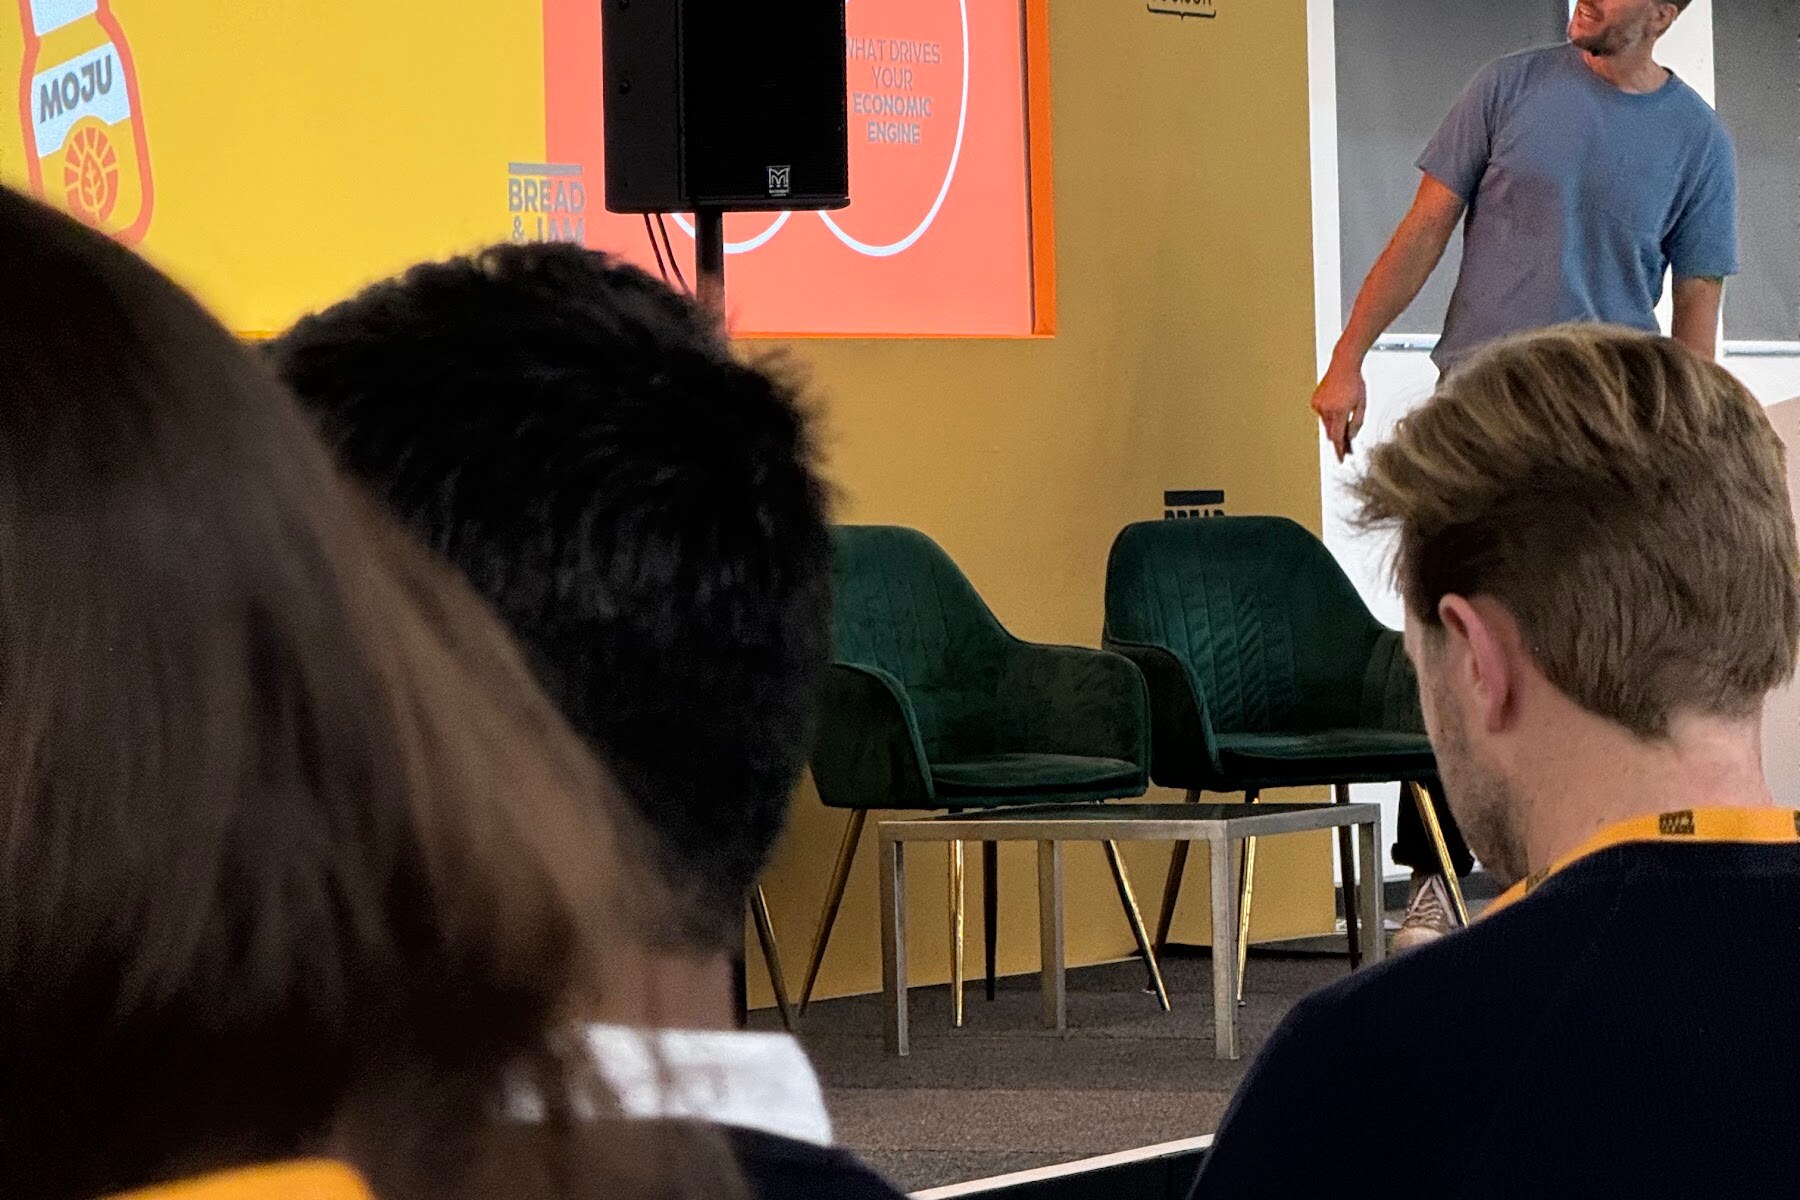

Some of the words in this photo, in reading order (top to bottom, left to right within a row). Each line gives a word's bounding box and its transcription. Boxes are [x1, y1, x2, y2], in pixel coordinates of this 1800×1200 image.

[889, 40, 940, 64] DRIVES
[40, 55, 112, 124] MOJU
[872, 66, 913, 91] YOUR
[853, 93, 932, 117] ECONOMIC
[868, 121, 920, 144] ENGINE
[508, 178, 585, 213] BREAD
